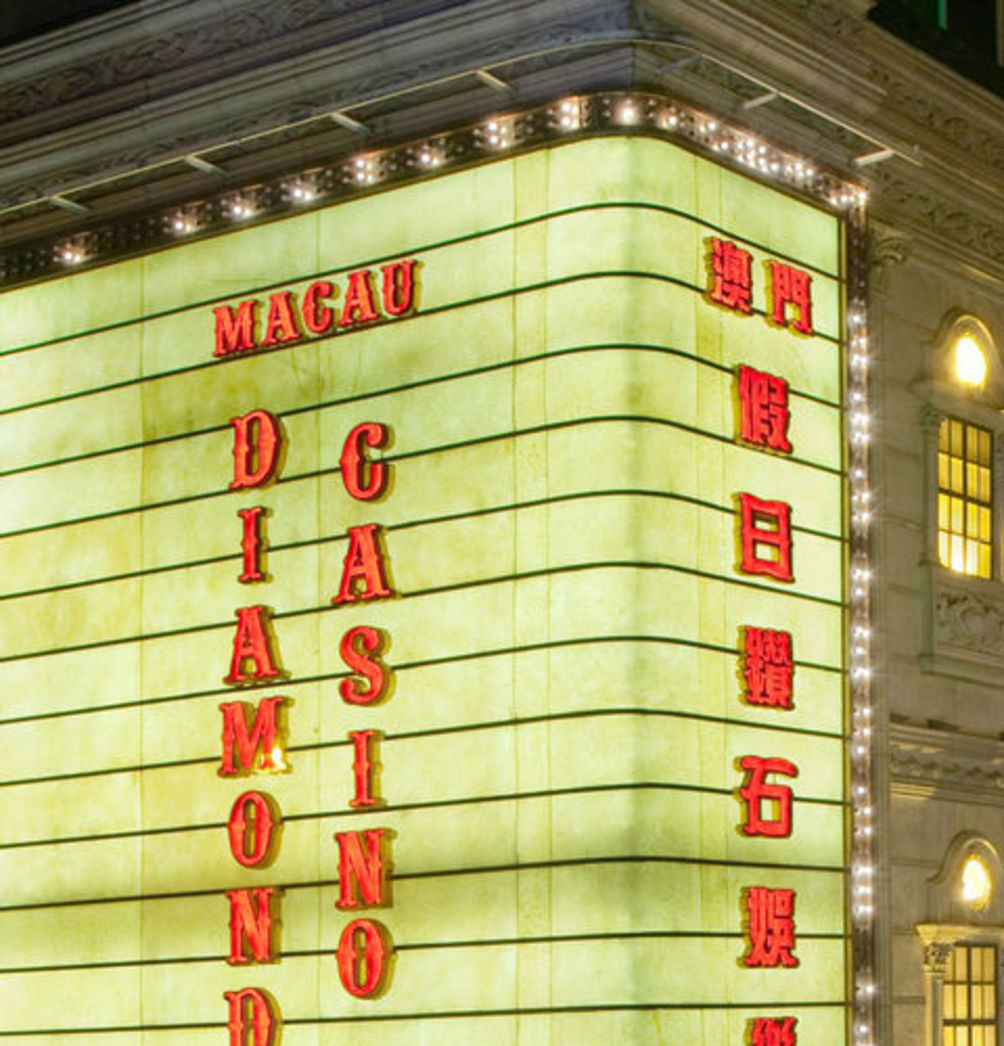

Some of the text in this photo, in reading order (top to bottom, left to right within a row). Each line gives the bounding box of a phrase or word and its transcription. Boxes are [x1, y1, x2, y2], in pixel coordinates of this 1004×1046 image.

[212, 260, 419, 357] MACAU
[707, 237, 813, 335] 澳門
[332, 421, 393, 998] CASINO
